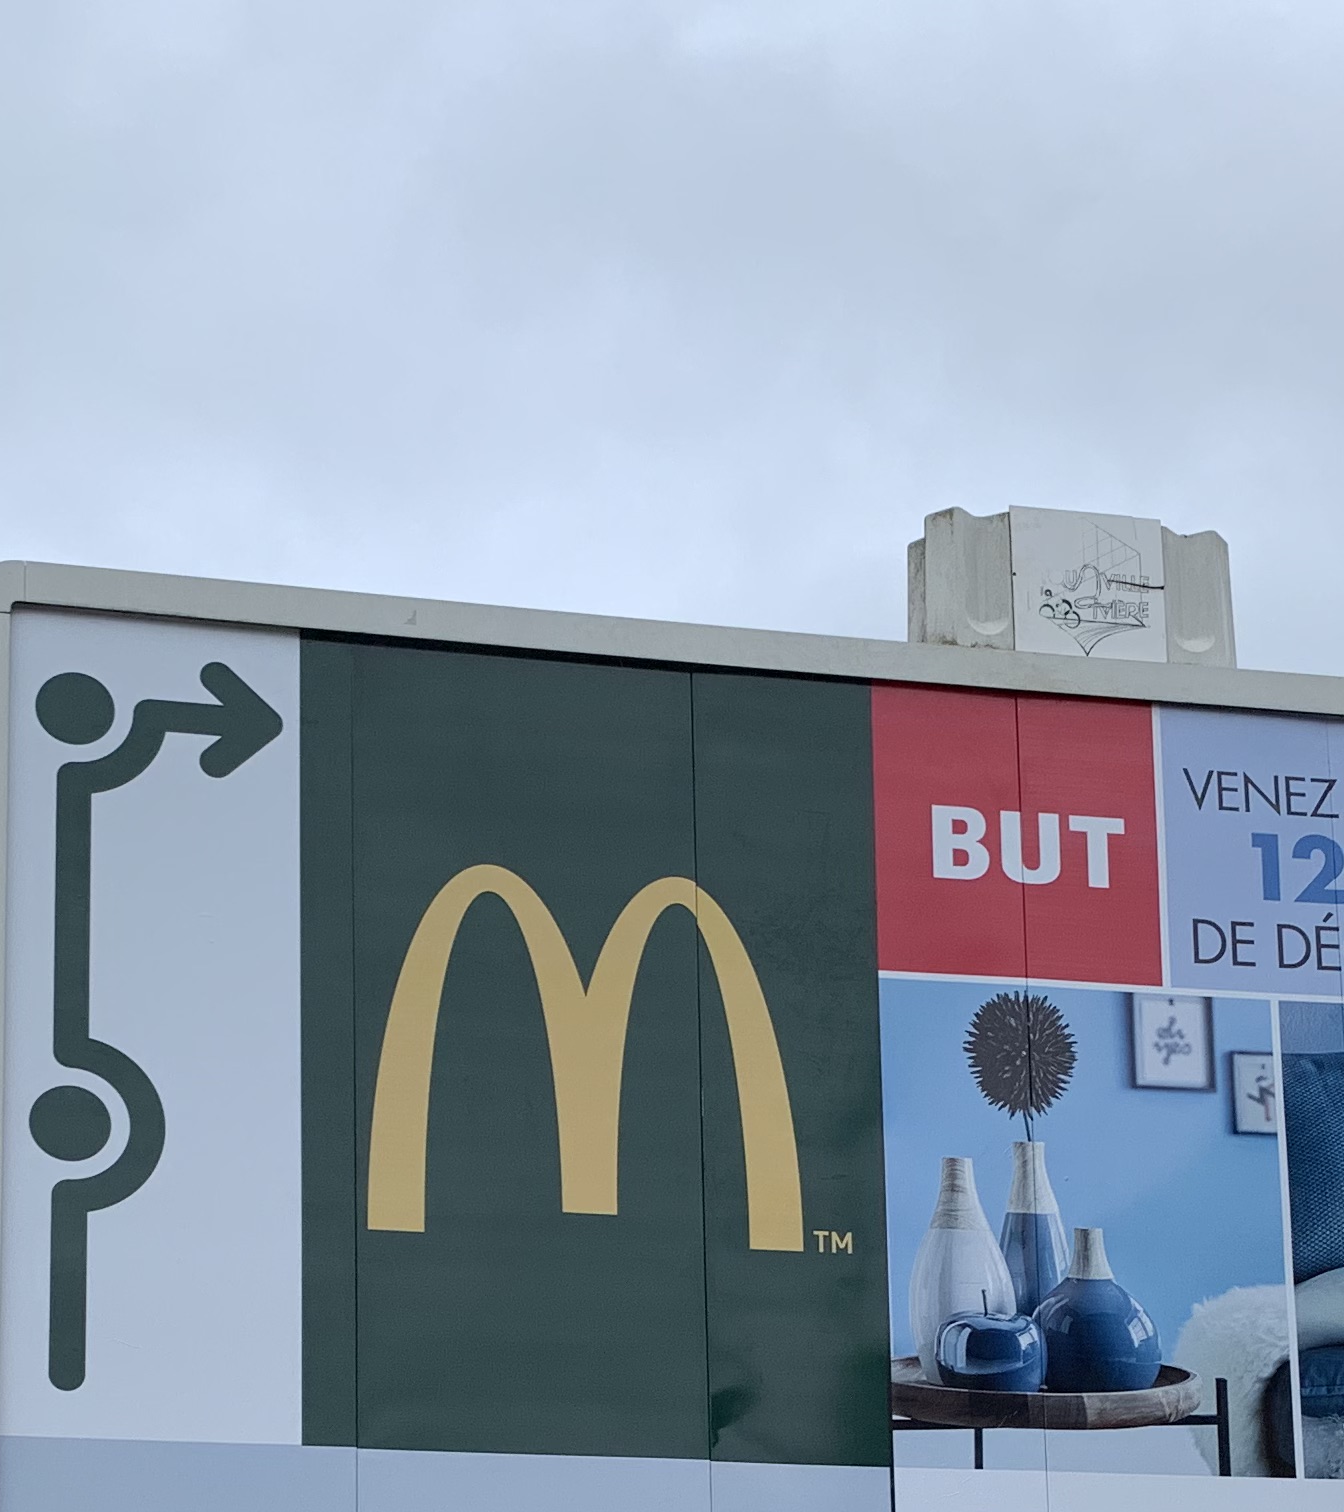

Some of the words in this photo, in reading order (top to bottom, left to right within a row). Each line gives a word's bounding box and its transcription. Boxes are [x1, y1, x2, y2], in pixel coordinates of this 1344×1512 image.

[1182, 768, 1337, 819] VENEZ
[930, 804, 1125, 889] BUT
[1191, 917, 1256, 967] DE
